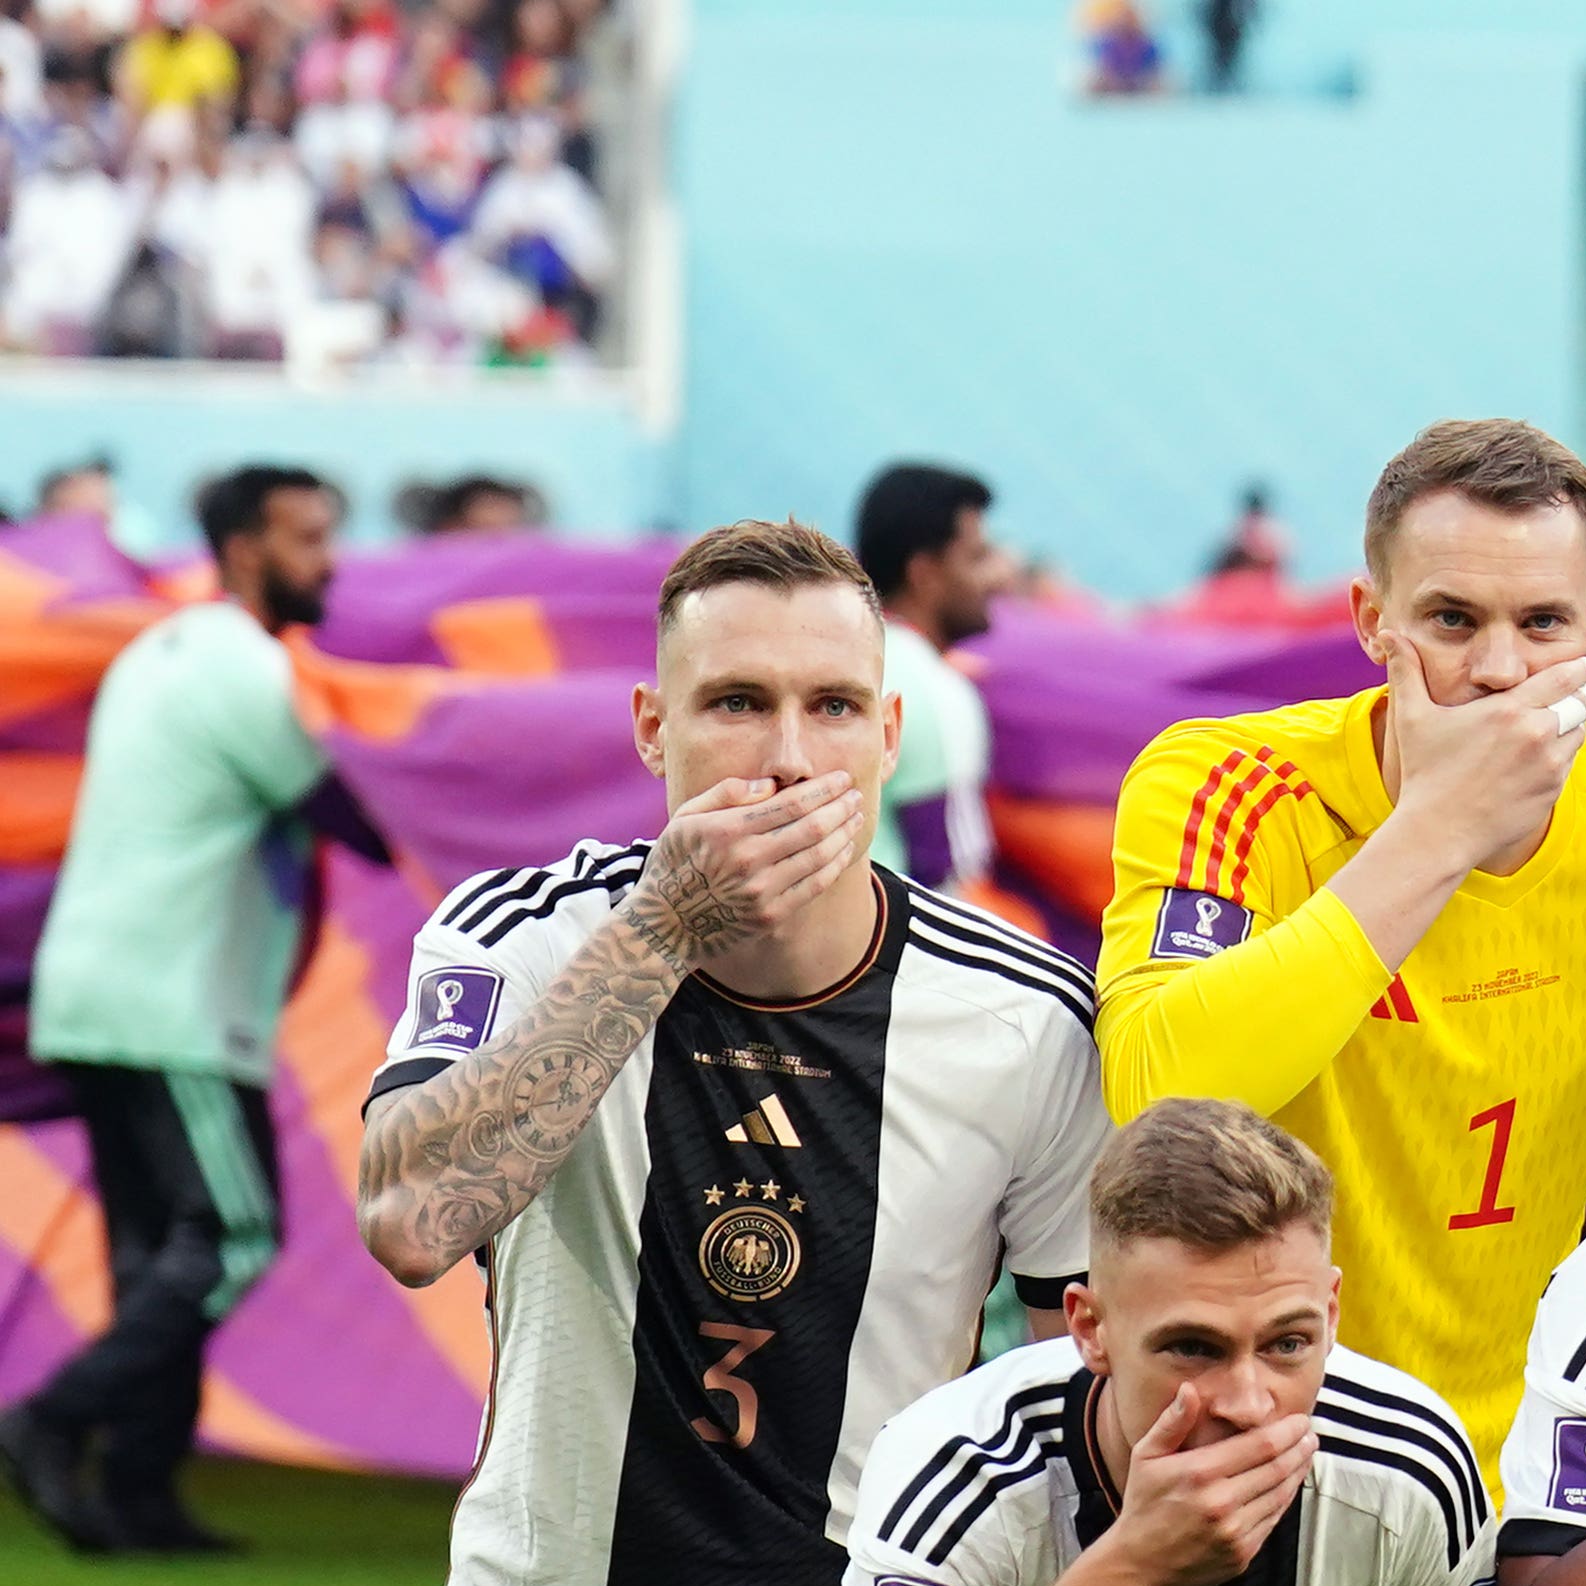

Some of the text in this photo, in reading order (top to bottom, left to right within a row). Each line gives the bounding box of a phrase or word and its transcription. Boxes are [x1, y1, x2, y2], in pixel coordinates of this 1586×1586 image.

[1442, 994, 1478, 1004] KHALIFA
[1480, 983, 1534, 1000] INTERNATIONAL
[1472, 984, 1482, 992] 23
[1484, 976, 1521, 990] NOVEMBER
[694, 1051, 726, 1065] KALIFA
[794, 1066, 832, 1078] STADIUM
[780, 1054, 802, 1065] 2022
[1447, 1097, 1517, 1231] 1
[723, 1218, 781, 1240] DEUTSCHER
[690, 1320, 776, 1448] 3
[1564, 1488, 1581, 1496] FIFA
